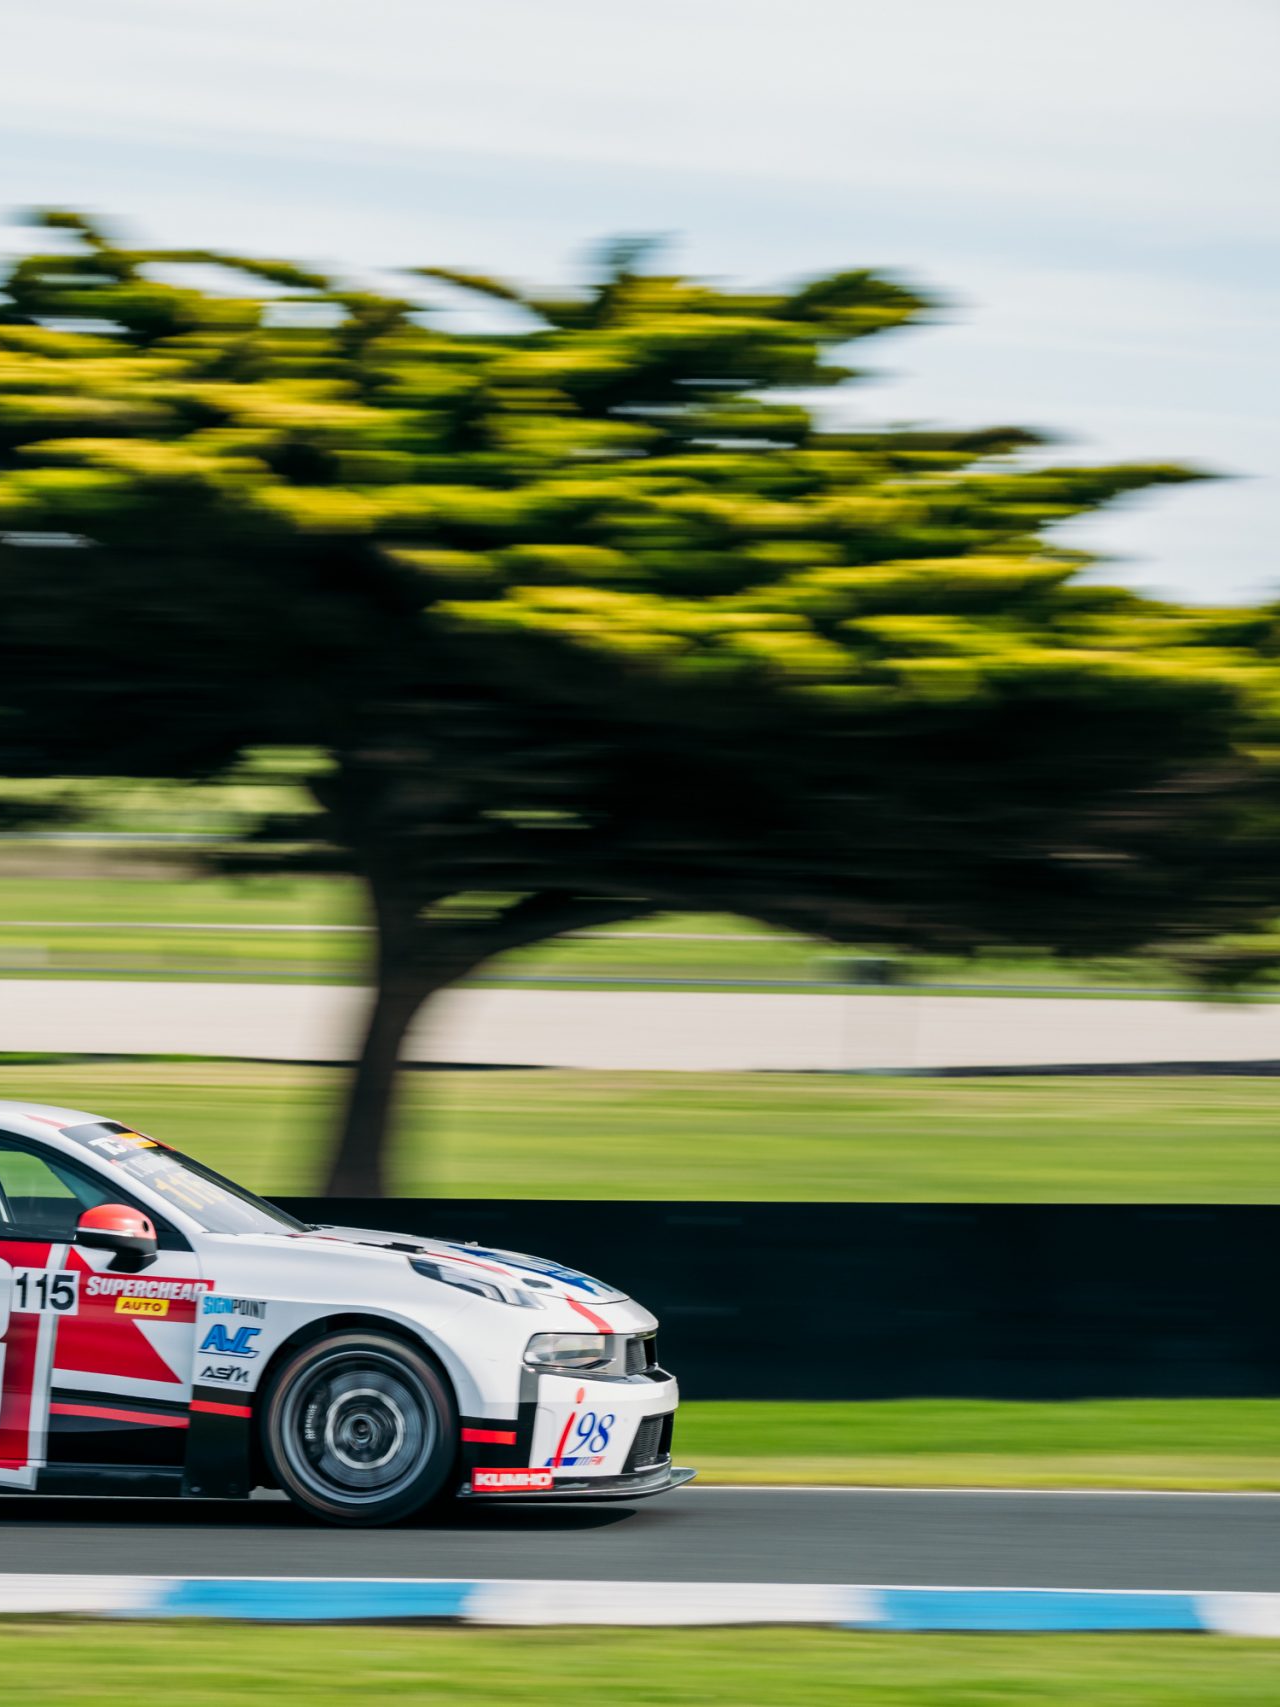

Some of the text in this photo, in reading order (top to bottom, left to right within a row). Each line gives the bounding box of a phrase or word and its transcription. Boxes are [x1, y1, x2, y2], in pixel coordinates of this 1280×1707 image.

[16, 1272, 76, 1311] 115
[122, 1301, 162, 1313] AUTO
[474, 1473, 552, 1487] KUMHO
